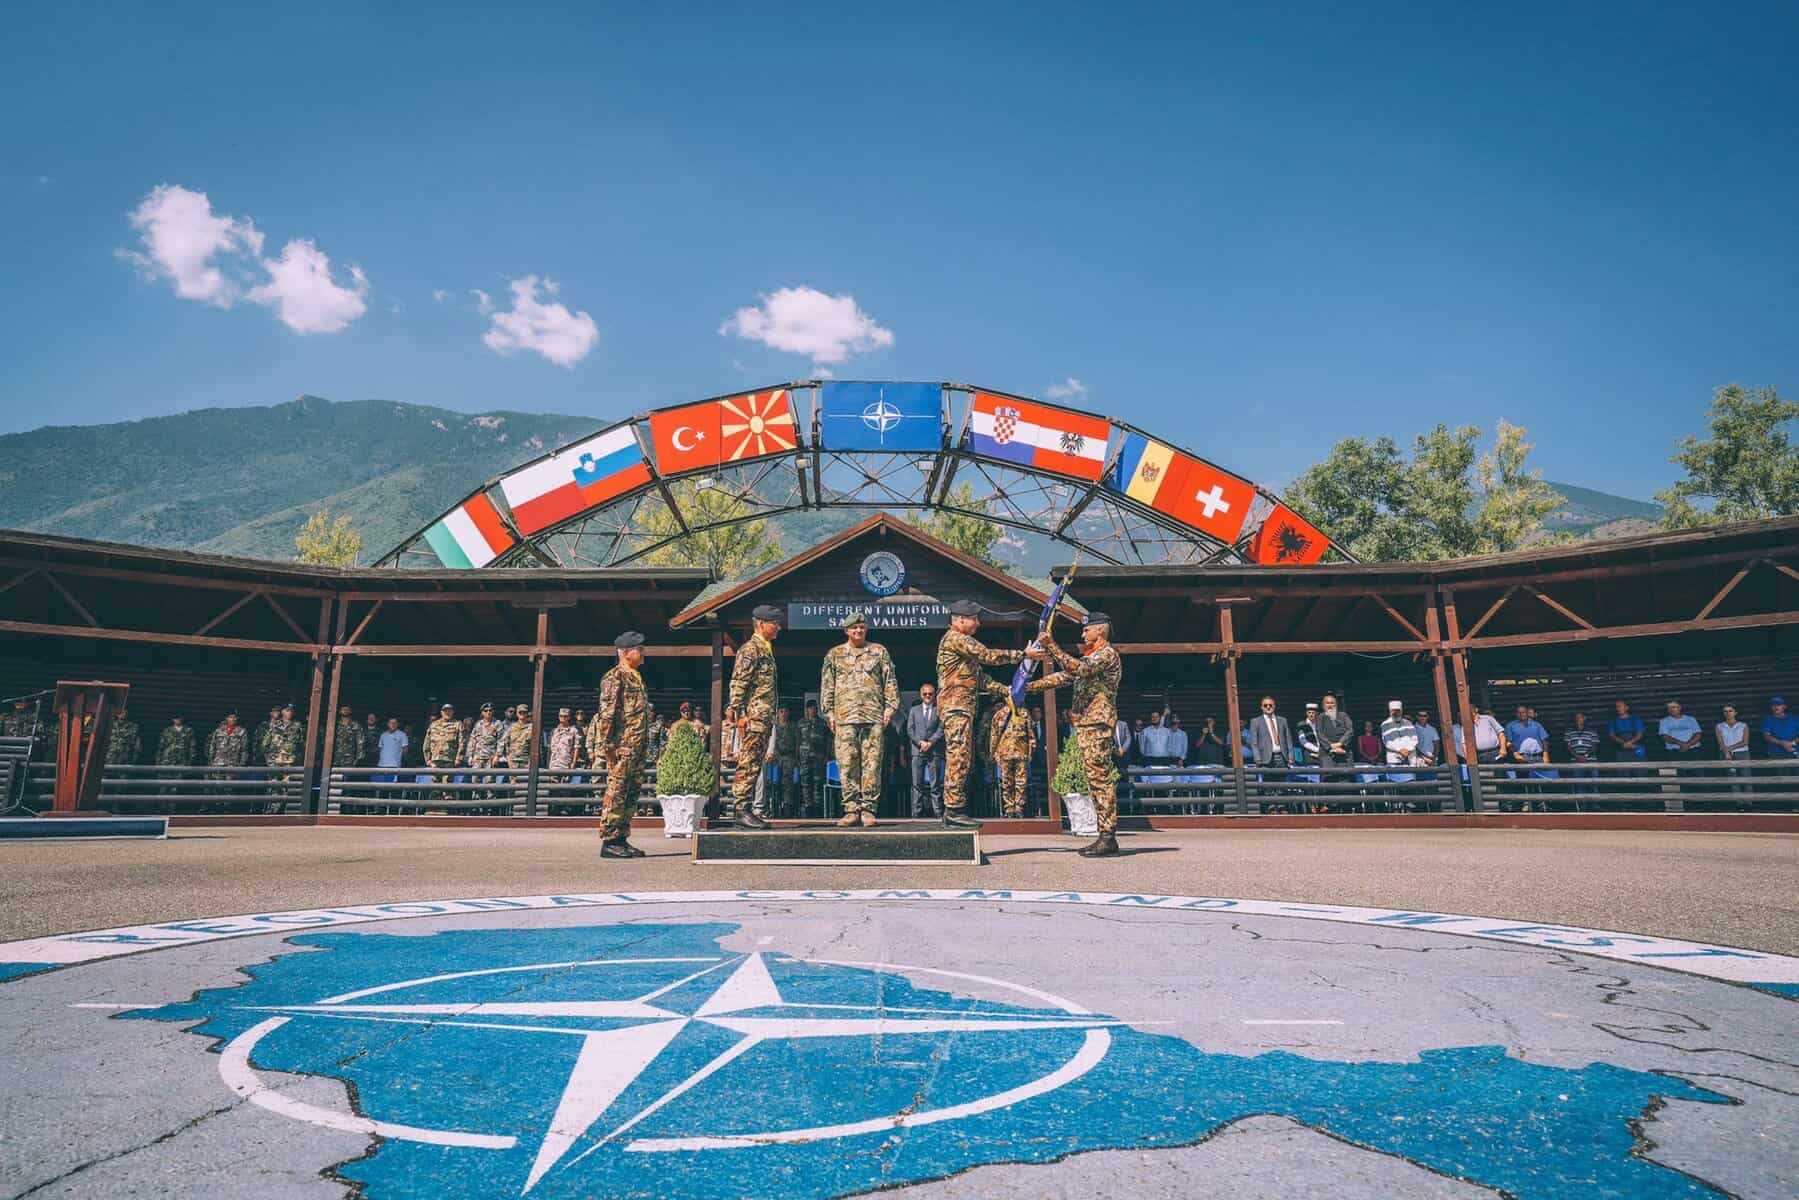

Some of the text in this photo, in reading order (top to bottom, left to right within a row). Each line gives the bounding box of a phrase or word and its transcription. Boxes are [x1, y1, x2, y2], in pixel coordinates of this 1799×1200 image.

[802, 604, 952, 616] DIFFERENT UNIFORM
[872, 616, 927, 627] VALUES
[57, 894, 664, 945] REGIONAL
[735, 889, 1239, 909] COMMAND
[1366, 912, 1769, 959] WEST
